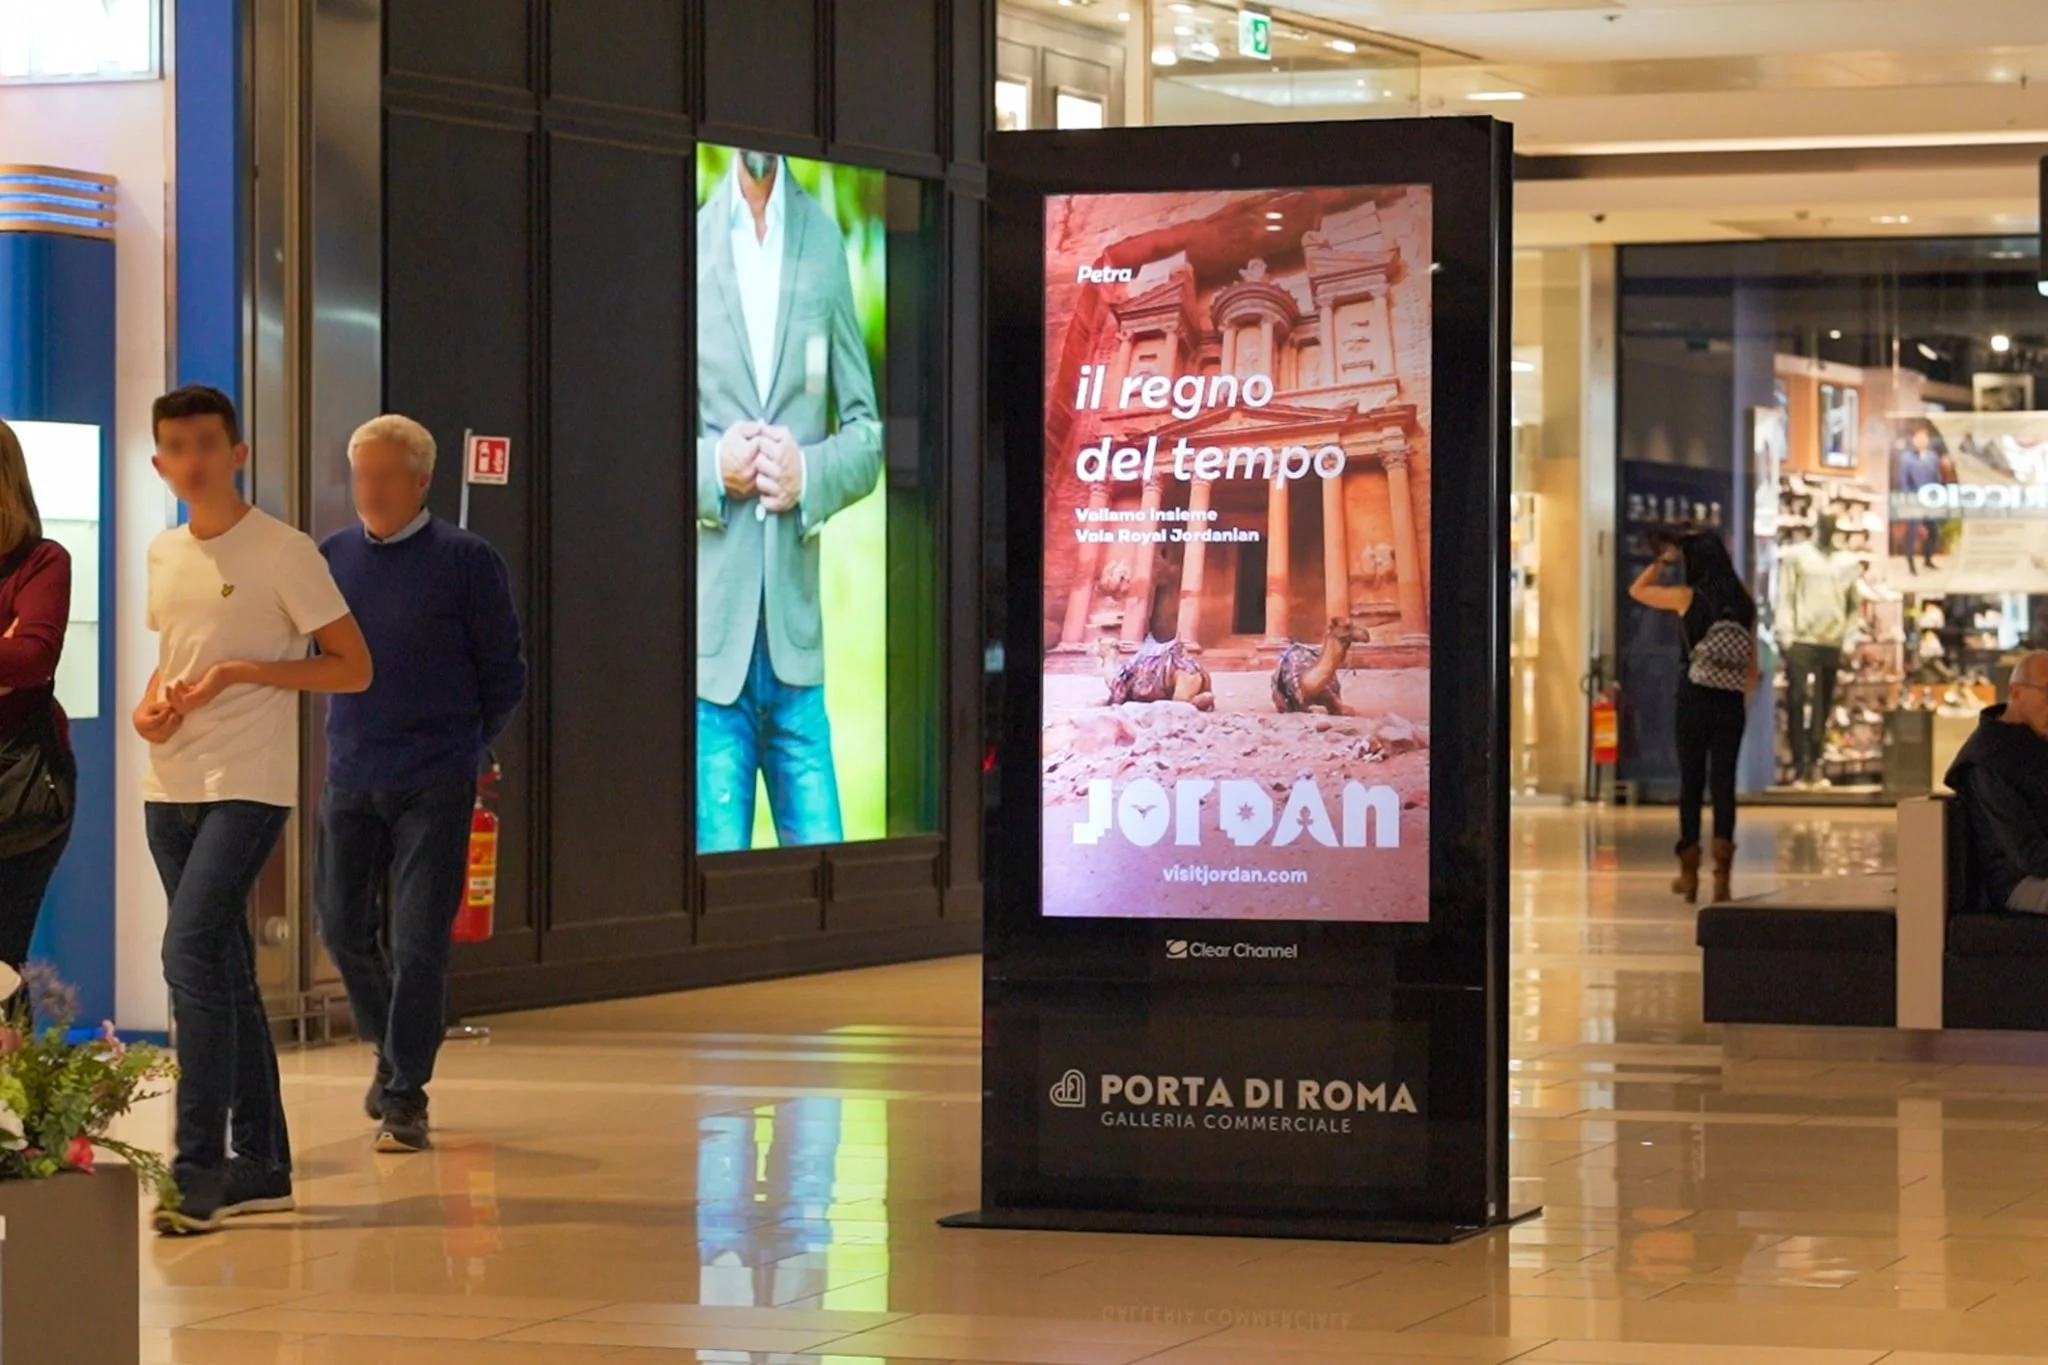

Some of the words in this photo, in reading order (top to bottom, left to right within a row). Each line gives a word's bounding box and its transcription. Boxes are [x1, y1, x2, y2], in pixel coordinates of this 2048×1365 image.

[1076, 264, 1133, 284] Petra
[1075, 364, 1106, 410] il
[1118, 372, 1275, 420] regno
[1075, 435, 1158, 482] del
[1171, 436, 1347, 490] tempo
[1074, 508, 1146, 522] Voliamo
[1074, 528, 1115, 543] Vola
[1118, 528, 1167, 545] Royal
[1170, 527, 1260, 542] Jordanian
[1162, 864, 1308, 886] visitjordan.com
[1189, 941, 1231, 959] Clear
[1233, 942, 1298, 960] Channel
[1100, 1073, 1235, 1109] PORTA
[1244, 1077, 1283, 1110] DI
[1296, 1079, 1419, 1114] ROMA
[1100, 1111, 1197, 1129] GALLERIA
[1203, 1113, 1352, 1134] COMMERCIALE
